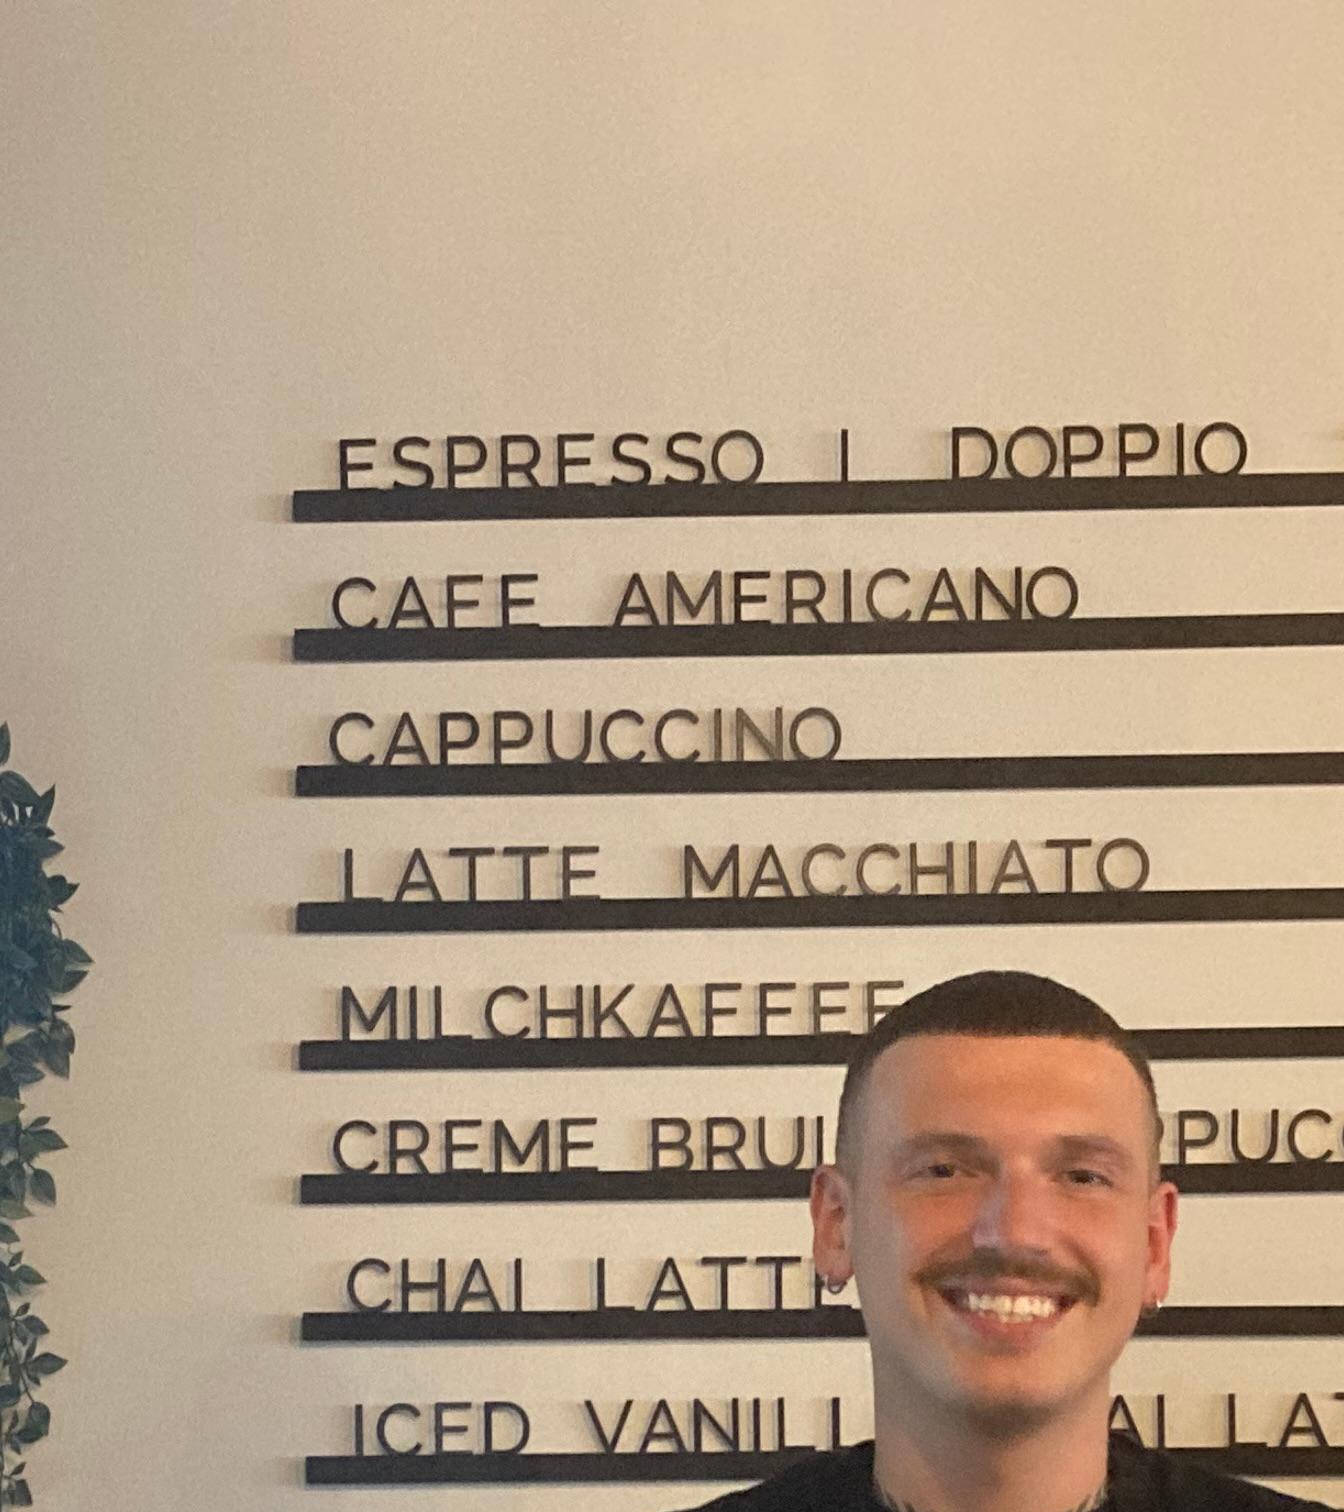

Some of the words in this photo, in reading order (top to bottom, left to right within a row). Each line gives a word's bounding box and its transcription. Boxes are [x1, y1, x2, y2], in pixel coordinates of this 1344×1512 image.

[339, 431, 765, 489] ESPRESSO
[951, 422, 1248, 480] DOPPIO
[332, 574, 540, 629] CAFE
[612, 566, 1079, 627] AMERICANO
[329, 707, 843, 765] CAPPUCCINO
[343, 845, 601, 901] LATTE
[683, 838, 1150, 899] MACCHIATO
[332, 1118, 599, 1175] CREME
[347, 1257, 523, 1314] CHAI
[356, 1402, 531, 1457] ICED
